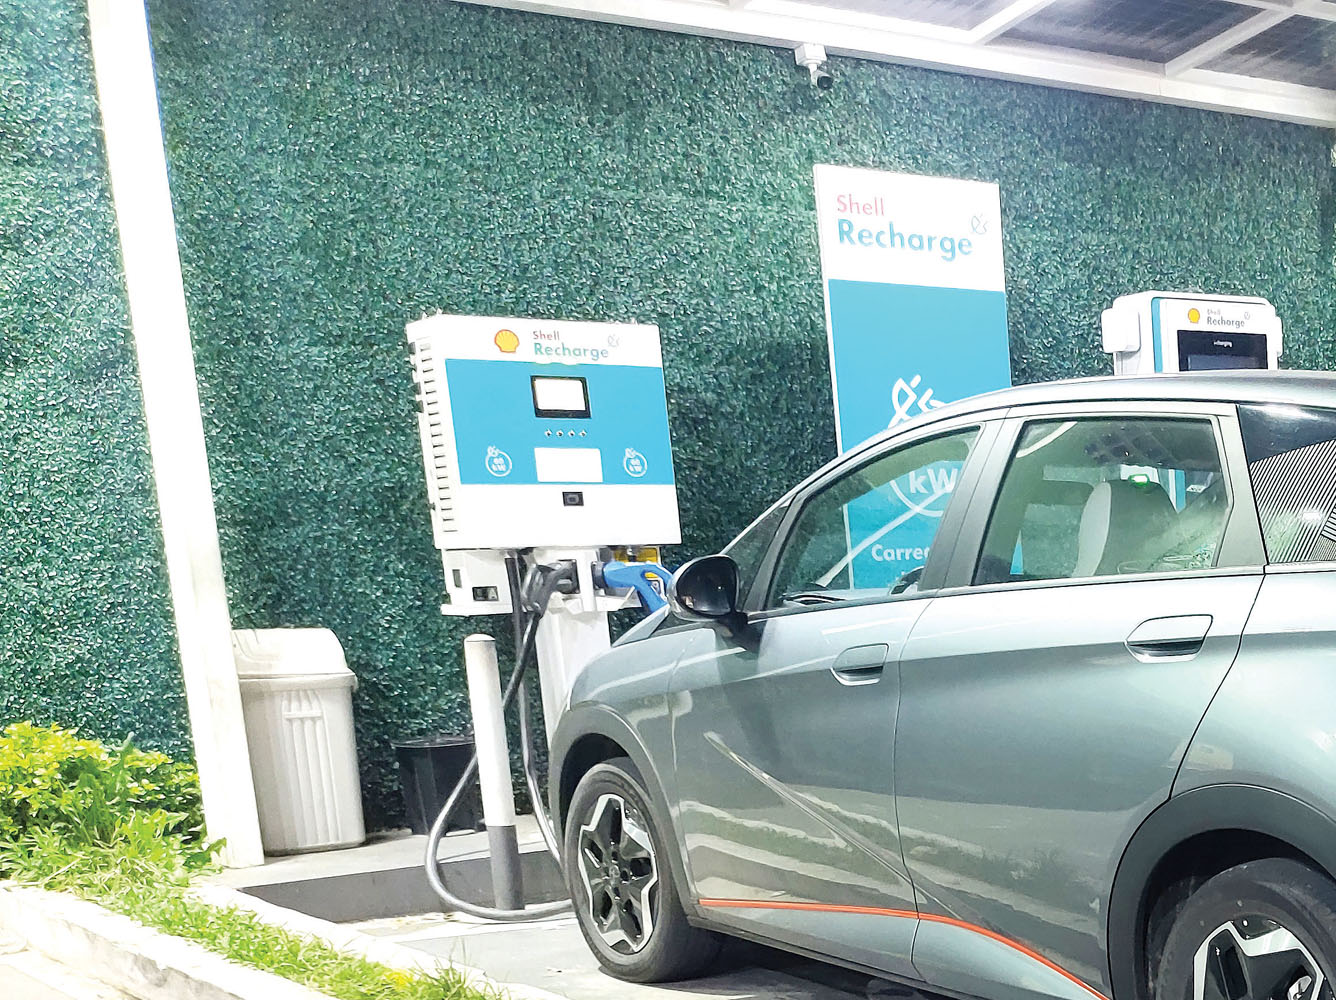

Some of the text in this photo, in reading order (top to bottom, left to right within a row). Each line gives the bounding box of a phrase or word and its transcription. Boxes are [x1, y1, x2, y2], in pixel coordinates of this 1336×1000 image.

[837, 194, 885, 216] Shell
[838, 218, 973, 262] Recharge
[1207, 316, 1245, 328] Recharge
[533, 330, 560, 341] Shell
[534, 342, 609, 361] Recharge
[909, 468, 958, 494] kW
